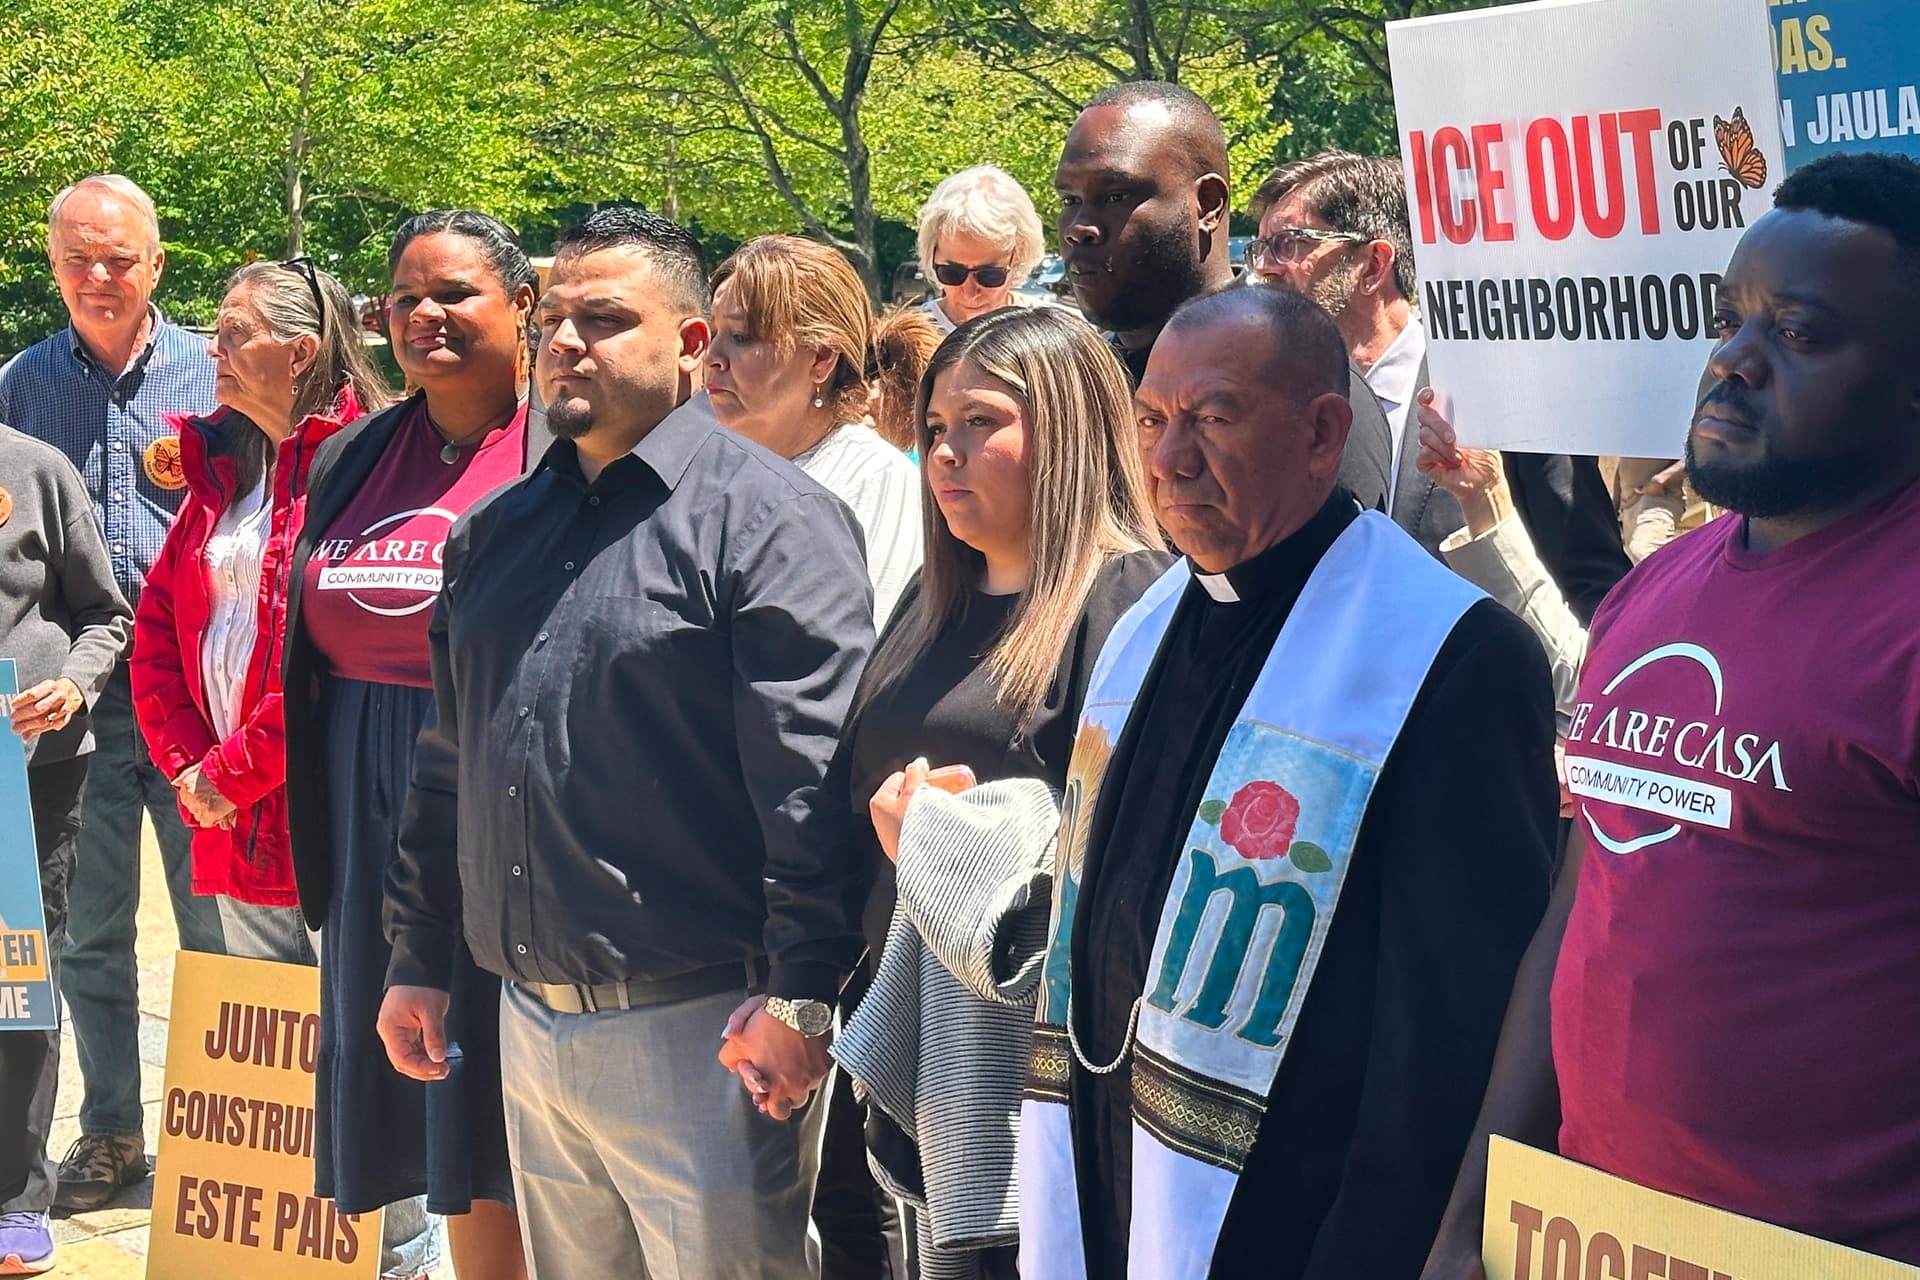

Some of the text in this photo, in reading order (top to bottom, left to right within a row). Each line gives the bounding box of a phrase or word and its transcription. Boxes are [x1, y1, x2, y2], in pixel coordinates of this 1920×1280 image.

[1770, 14, 1846, 75] AS.
[1668, 118, 1705, 171] OF
[1807, 85, 1920, 145] JAULA
[1409, 108, 1662, 245] ICE OUT
[1673, 178, 1745, 232] OUR
[1425, 273, 1722, 341] NEIGHBORHOOD
[327, 572, 414, 585] COMMUNITY
[354, 540, 428, 562] ARE
[1568, 702, 1792, 792] E ARE CASA
[1570, 765, 1716, 815] COMMUNITY POWER
[0, 934, 37, 967] EH
[204, 1001, 321, 1074] JUNTO
[165, 1087, 316, 1159] CONSTRUI
[174, 1175, 263, 1248] ESTE
